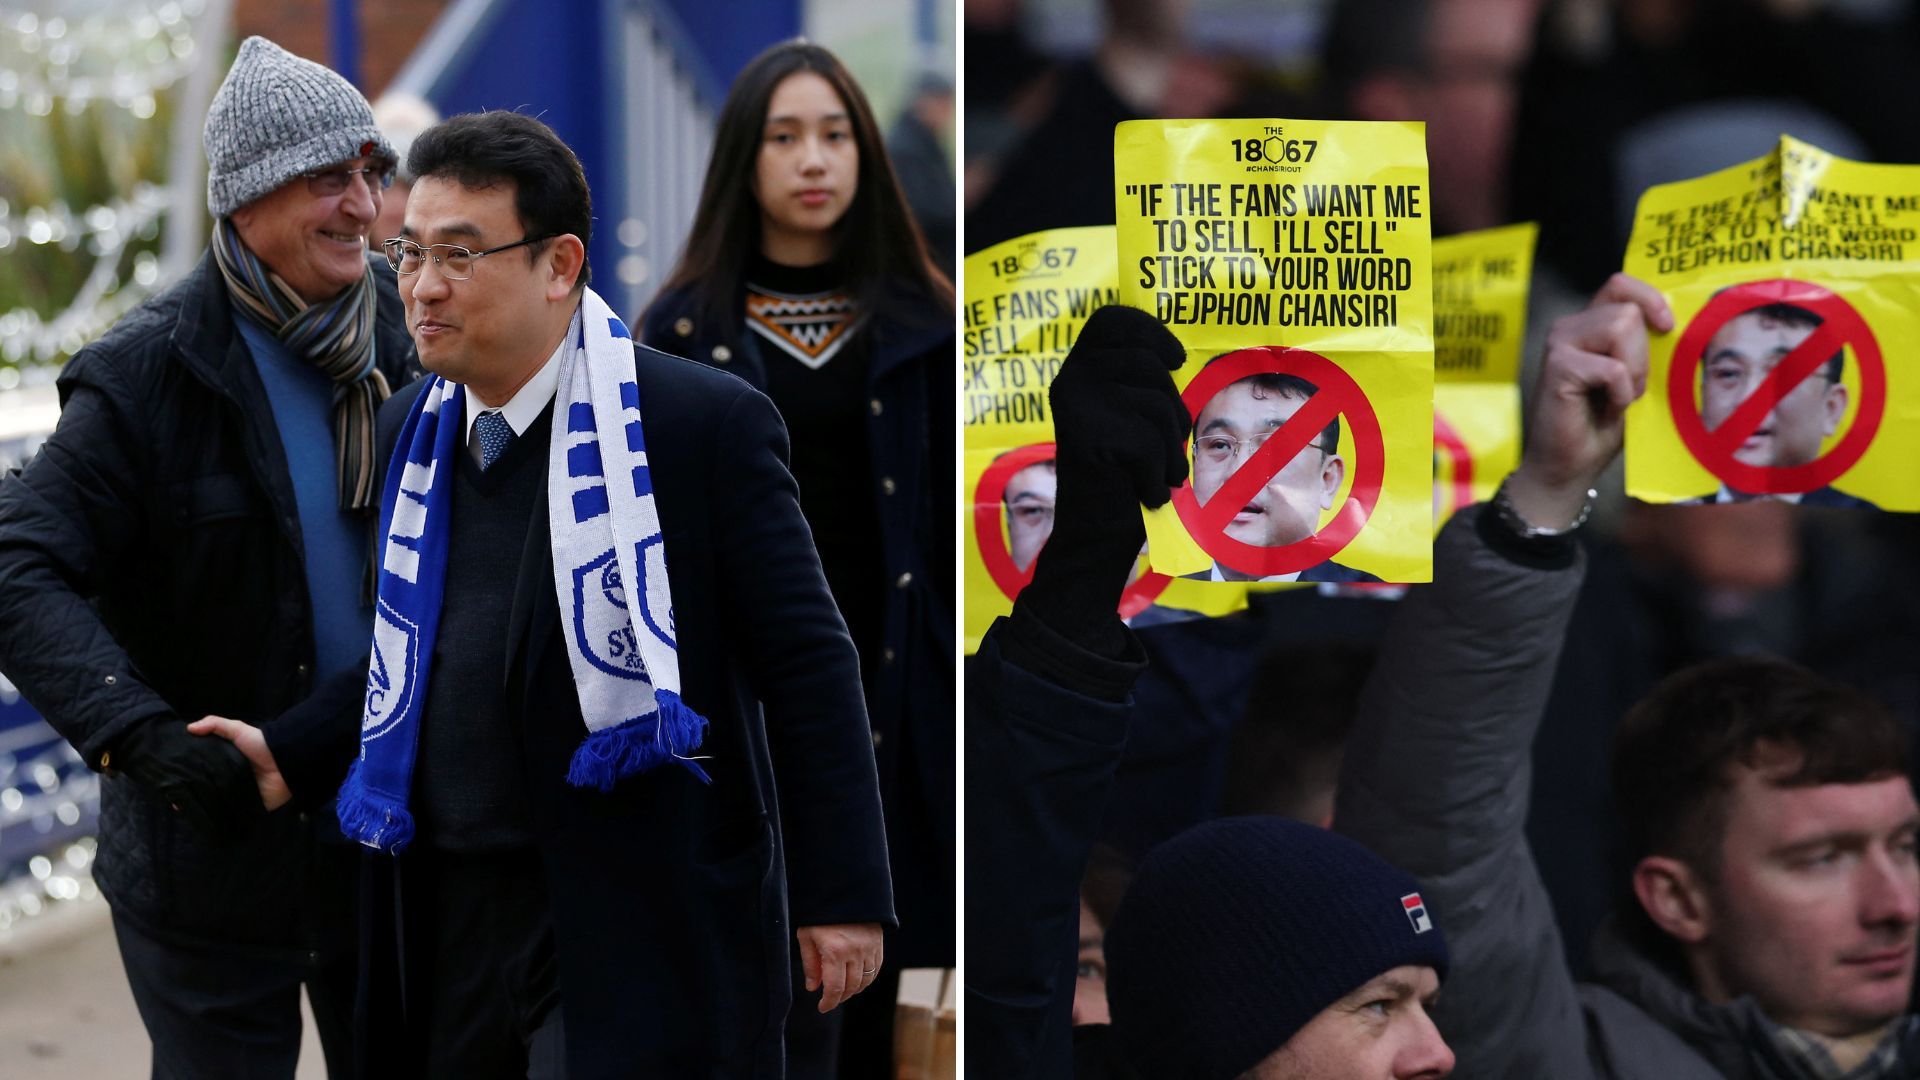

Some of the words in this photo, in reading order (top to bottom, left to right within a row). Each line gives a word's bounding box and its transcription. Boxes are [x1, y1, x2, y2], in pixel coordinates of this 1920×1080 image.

[1263, 126, 1283, 135] THE
[1246, 165, 1302, 173] #CHANSIRIOUT
[1125, 184, 1166, 217] "IF
[1171, 184, 1222, 217] THE
[1230, 184, 1297, 218] FANS
[1303, 185, 1376, 218] WANT
[1385, 185, 1422, 218] ME
[1884, 195, 1919, 211] ME
[1153, 220, 1187, 253] TO
[1195, 220, 1265, 258] SELL,
[1274, 221, 1316, 254] I'LL
[1324, 221, 1397, 254] SELL"
[1645, 231, 1717, 257] STICK
[1728, 219, 1758, 242] TO
[1839, 227, 1917, 242] WORD
[1658, 239, 1771, 274] DEJPHON
[1781, 236, 1903, 260] CHANSIRI
[1139, 256, 1217, 289] STICK
[1223, 257, 1255, 289] TO
[1263, 257, 1328, 291] YOUR
[1337, 258, 1411, 291] WORD
[993, 288, 1059, 321] FANS
[1157, 292, 1271, 326] DEJPHON
[1279, 293, 1397, 327] CHANSIRI
[994, 358, 1026, 388] TO
